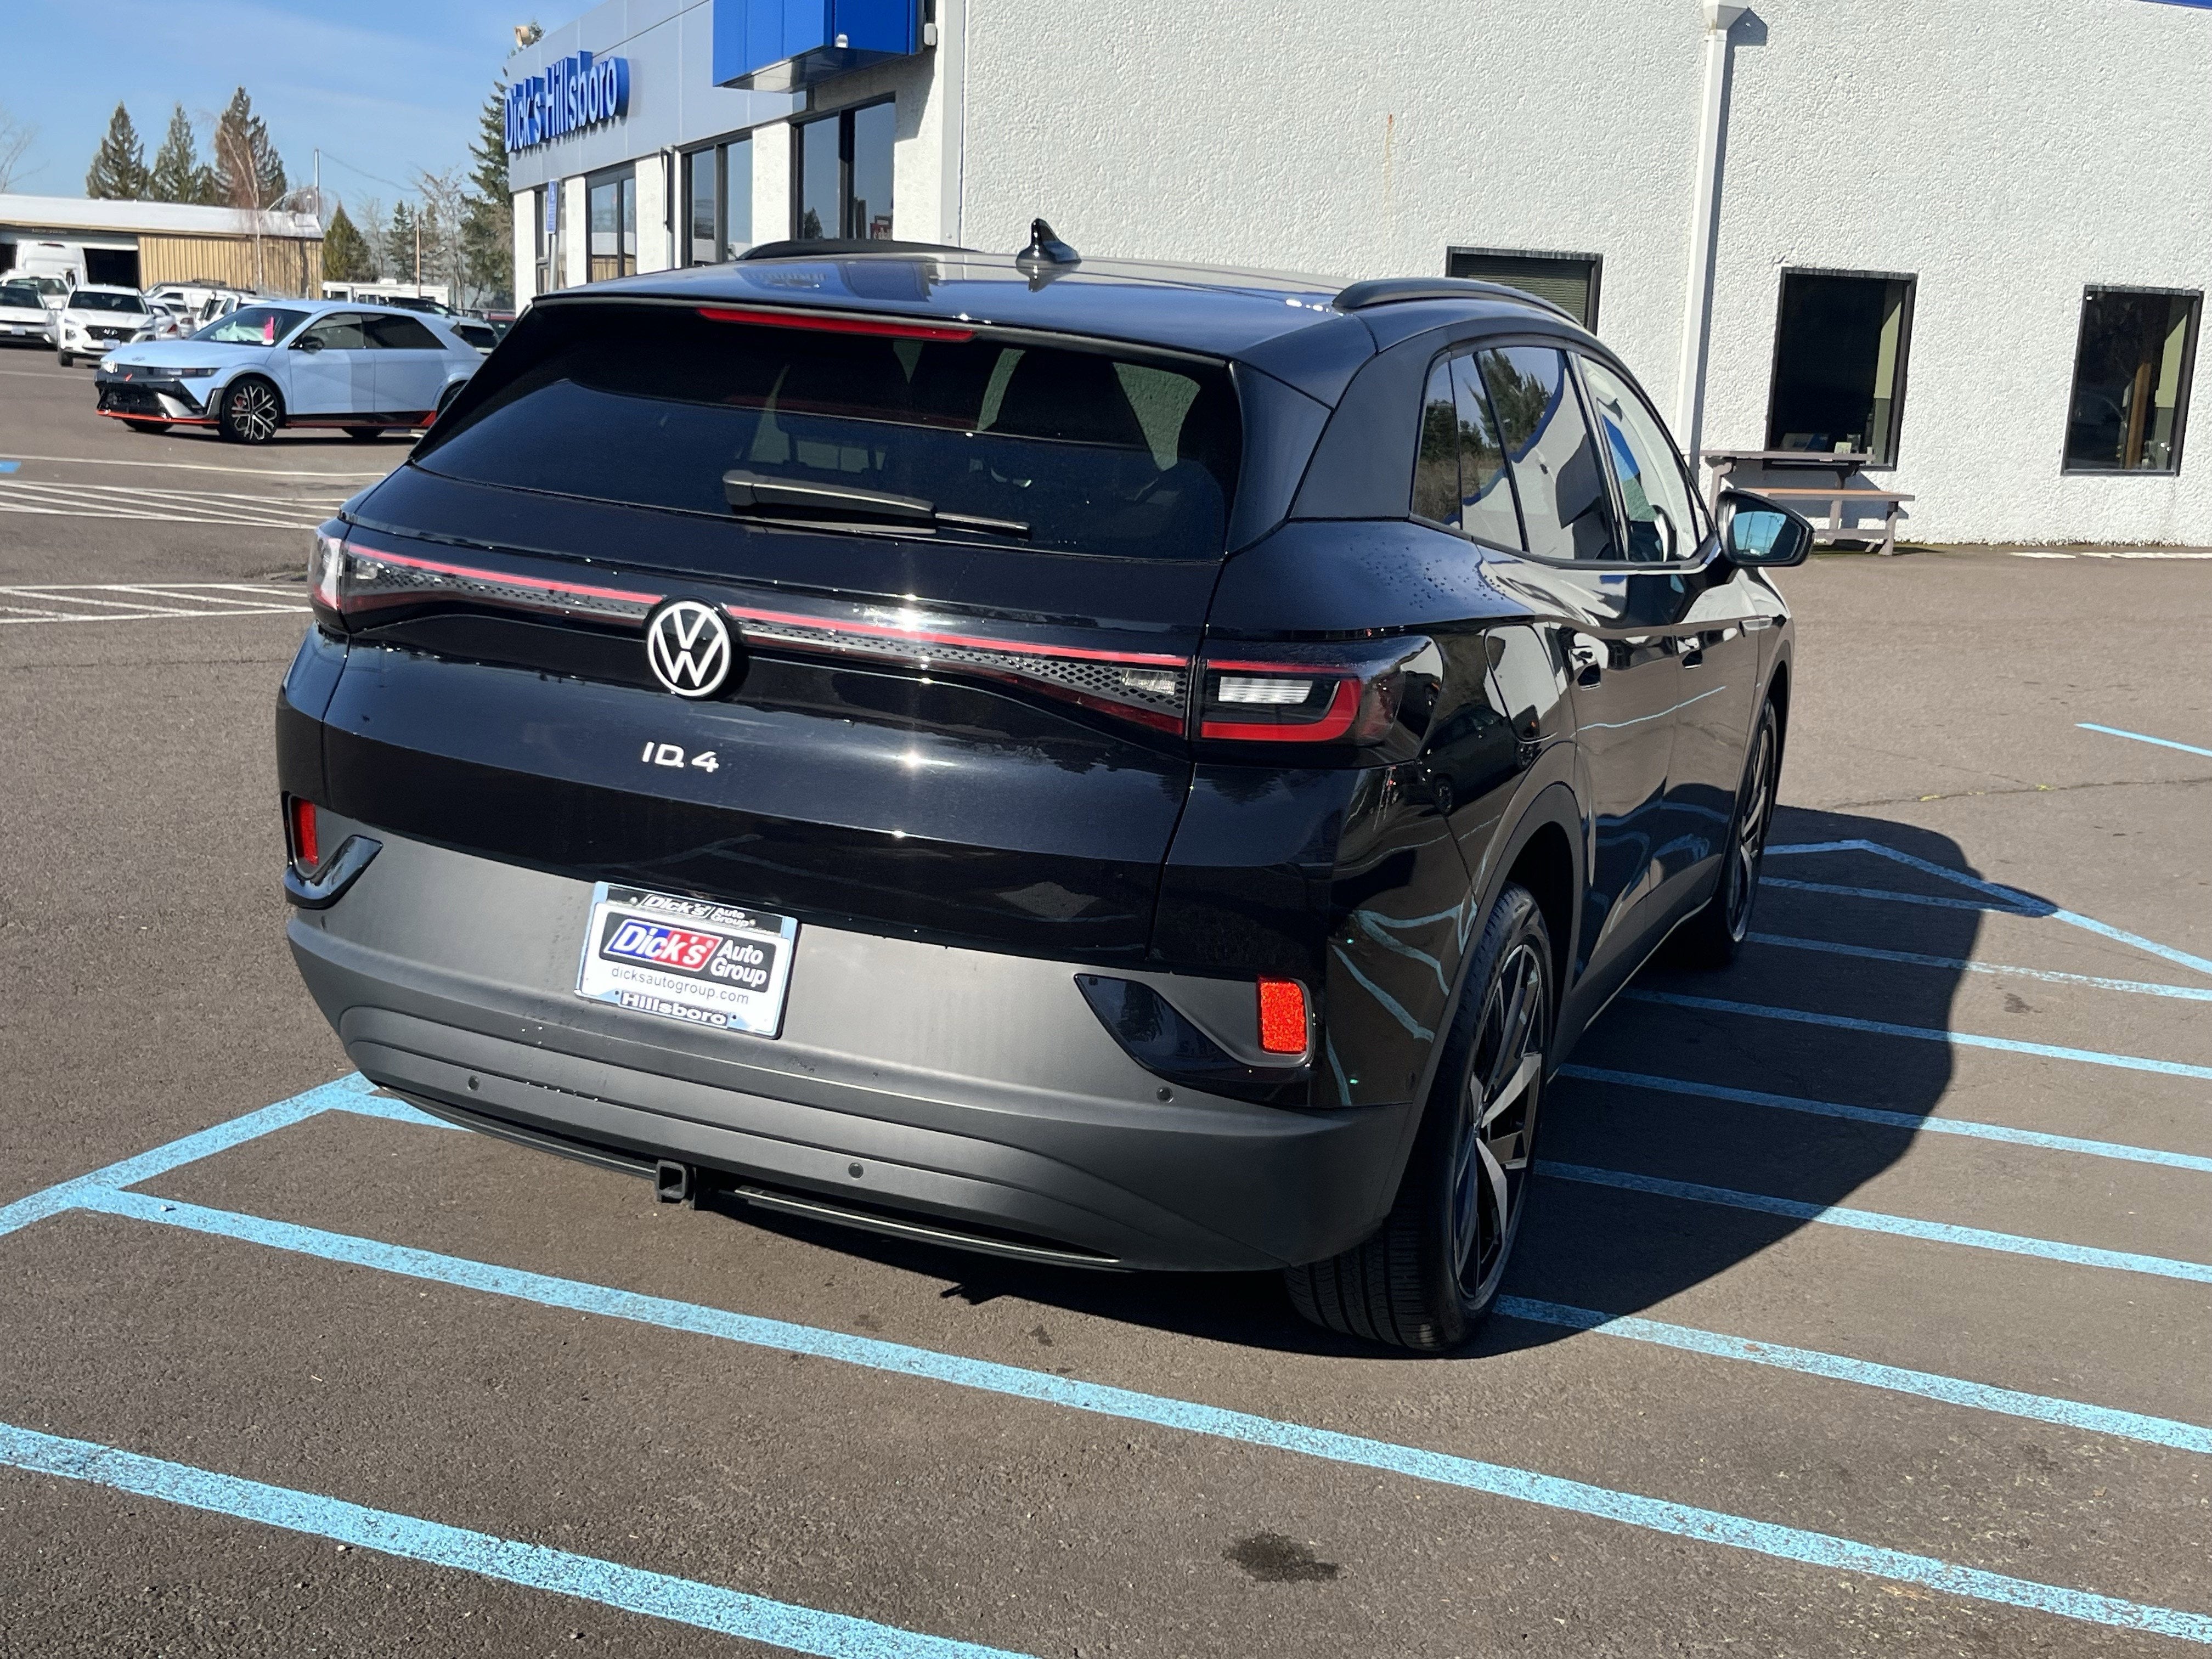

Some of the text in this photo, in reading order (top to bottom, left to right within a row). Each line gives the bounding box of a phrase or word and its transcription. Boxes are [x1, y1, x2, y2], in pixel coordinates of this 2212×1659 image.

[505, 50, 619, 154] Dick's Hillsboro
[653, 606, 725, 690] VW
[644, 895, 712, 917] Dick's
[710, 913, 751, 928] Group
[715, 907, 746, 919] Auto
[612, 924, 708, 967] Dick's
[717, 939, 764, 965] Auto
[611, 966, 749, 1006] dicksautogroup.com
[710, 957, 768, 988] Group
[621, 991, 727, 1026] Hillsboro
